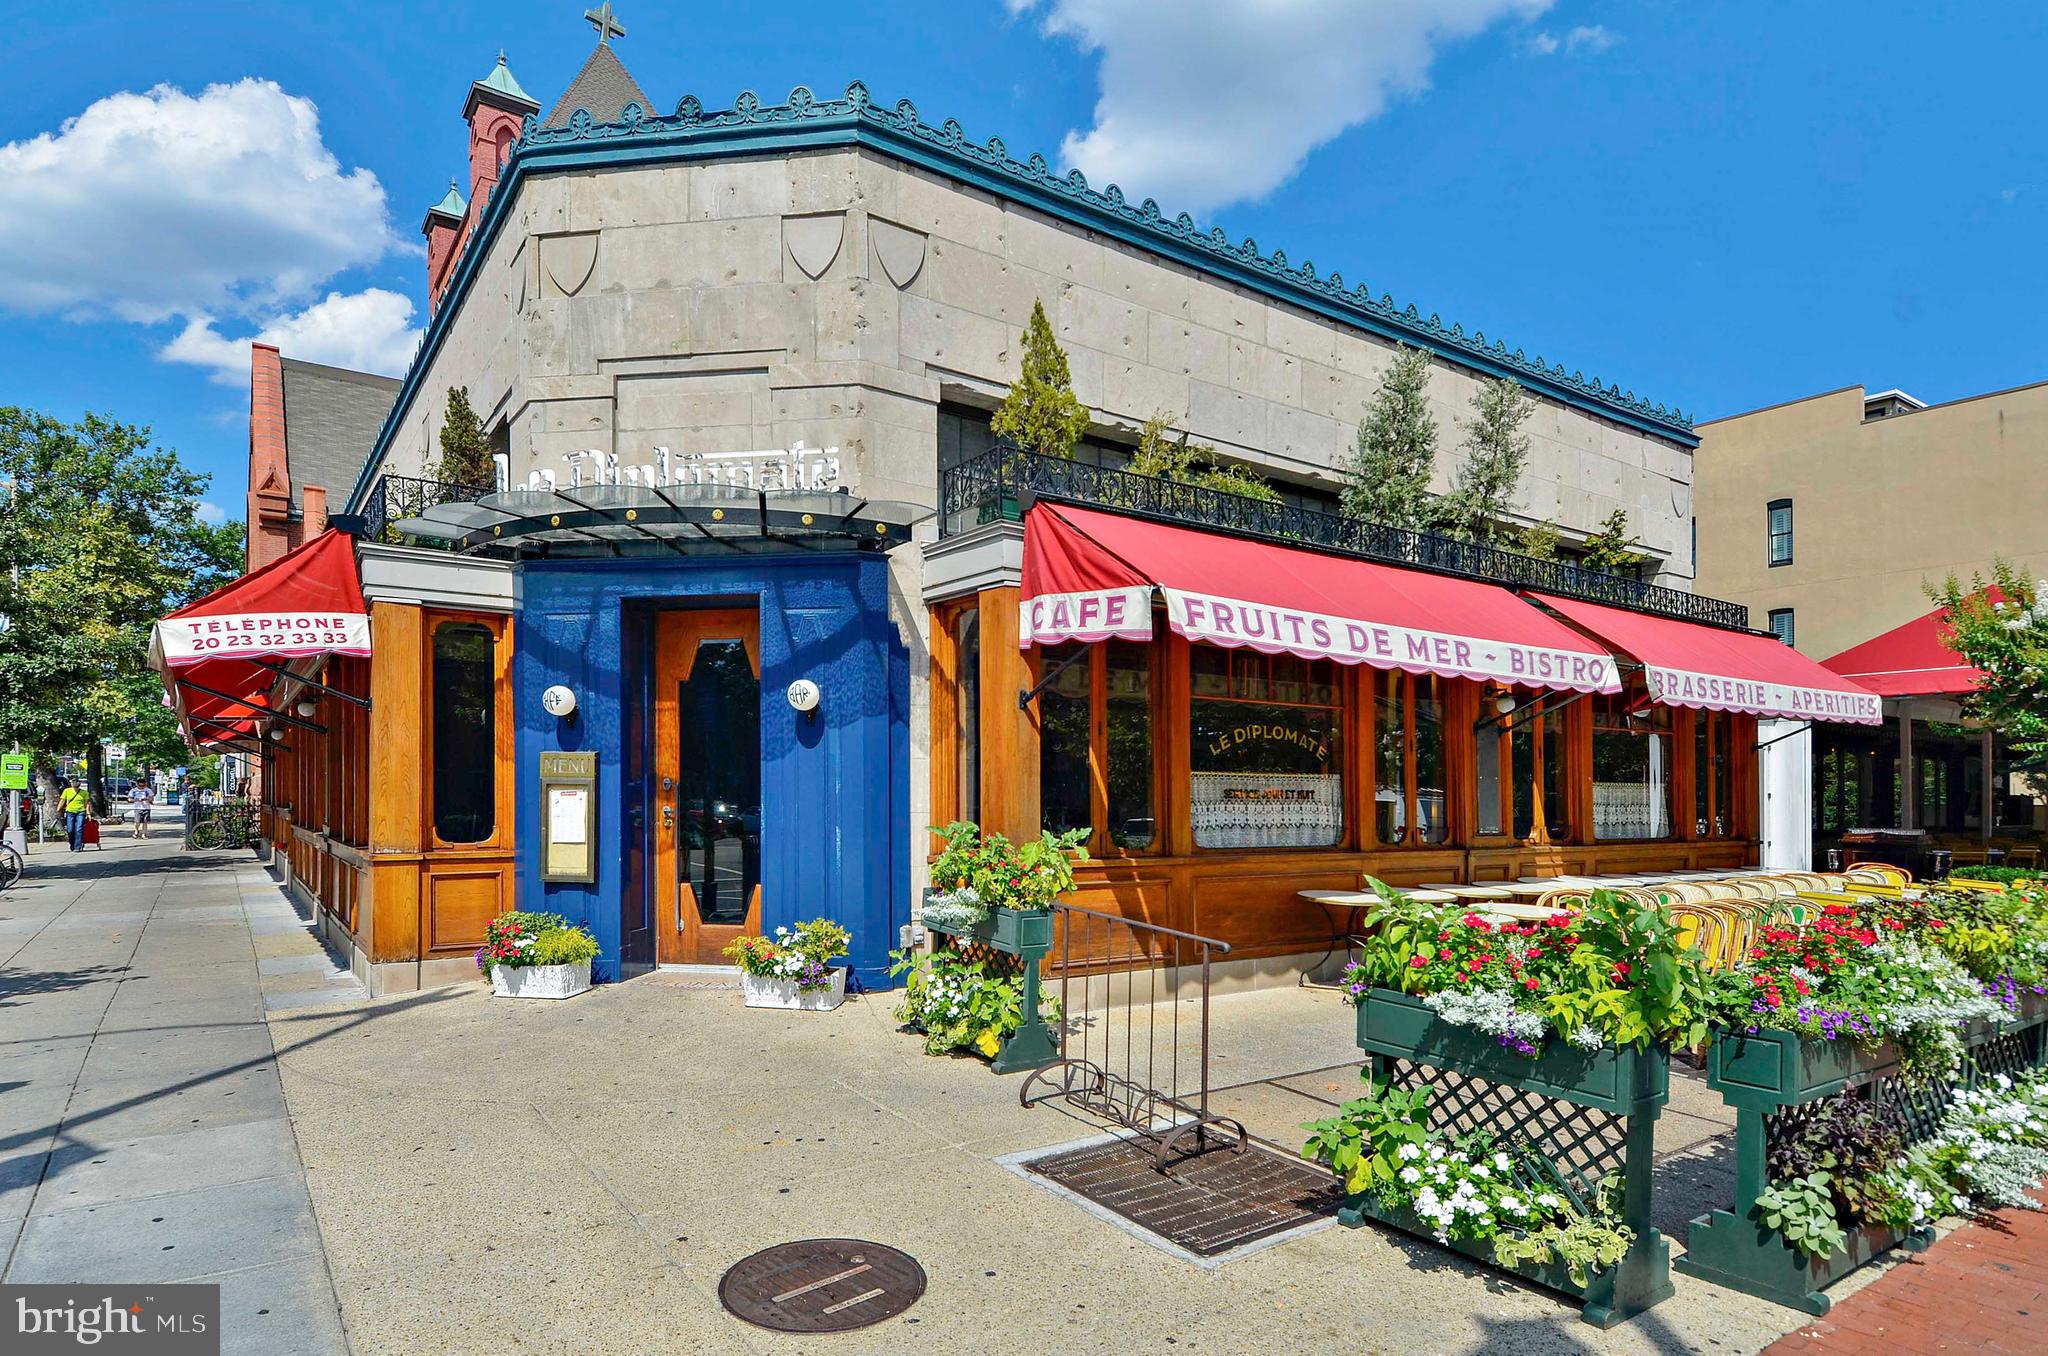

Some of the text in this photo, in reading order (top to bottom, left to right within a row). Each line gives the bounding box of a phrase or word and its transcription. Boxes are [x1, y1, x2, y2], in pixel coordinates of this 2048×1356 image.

[188, 618, 346, 635] TÉLÉPHONE
[1031, 595, 1127, 631] CAFE
[191, 632, 348, 651] 20 23 32 33 33
[1182, 597, 1332, 648] FRUITS
[1345, 623, 1393, 656] DE
[1404, 633, 1473, 668] MER
[1509, 648, 1604, 683] BISTRO
[1652, 669, 1767, 706] BRASSERIE
[1209, 724, 1329, 762] LE DIPLOMATE
[544, 758, 591, 774] MENU
[1285, 789, 1296, 800] ET
